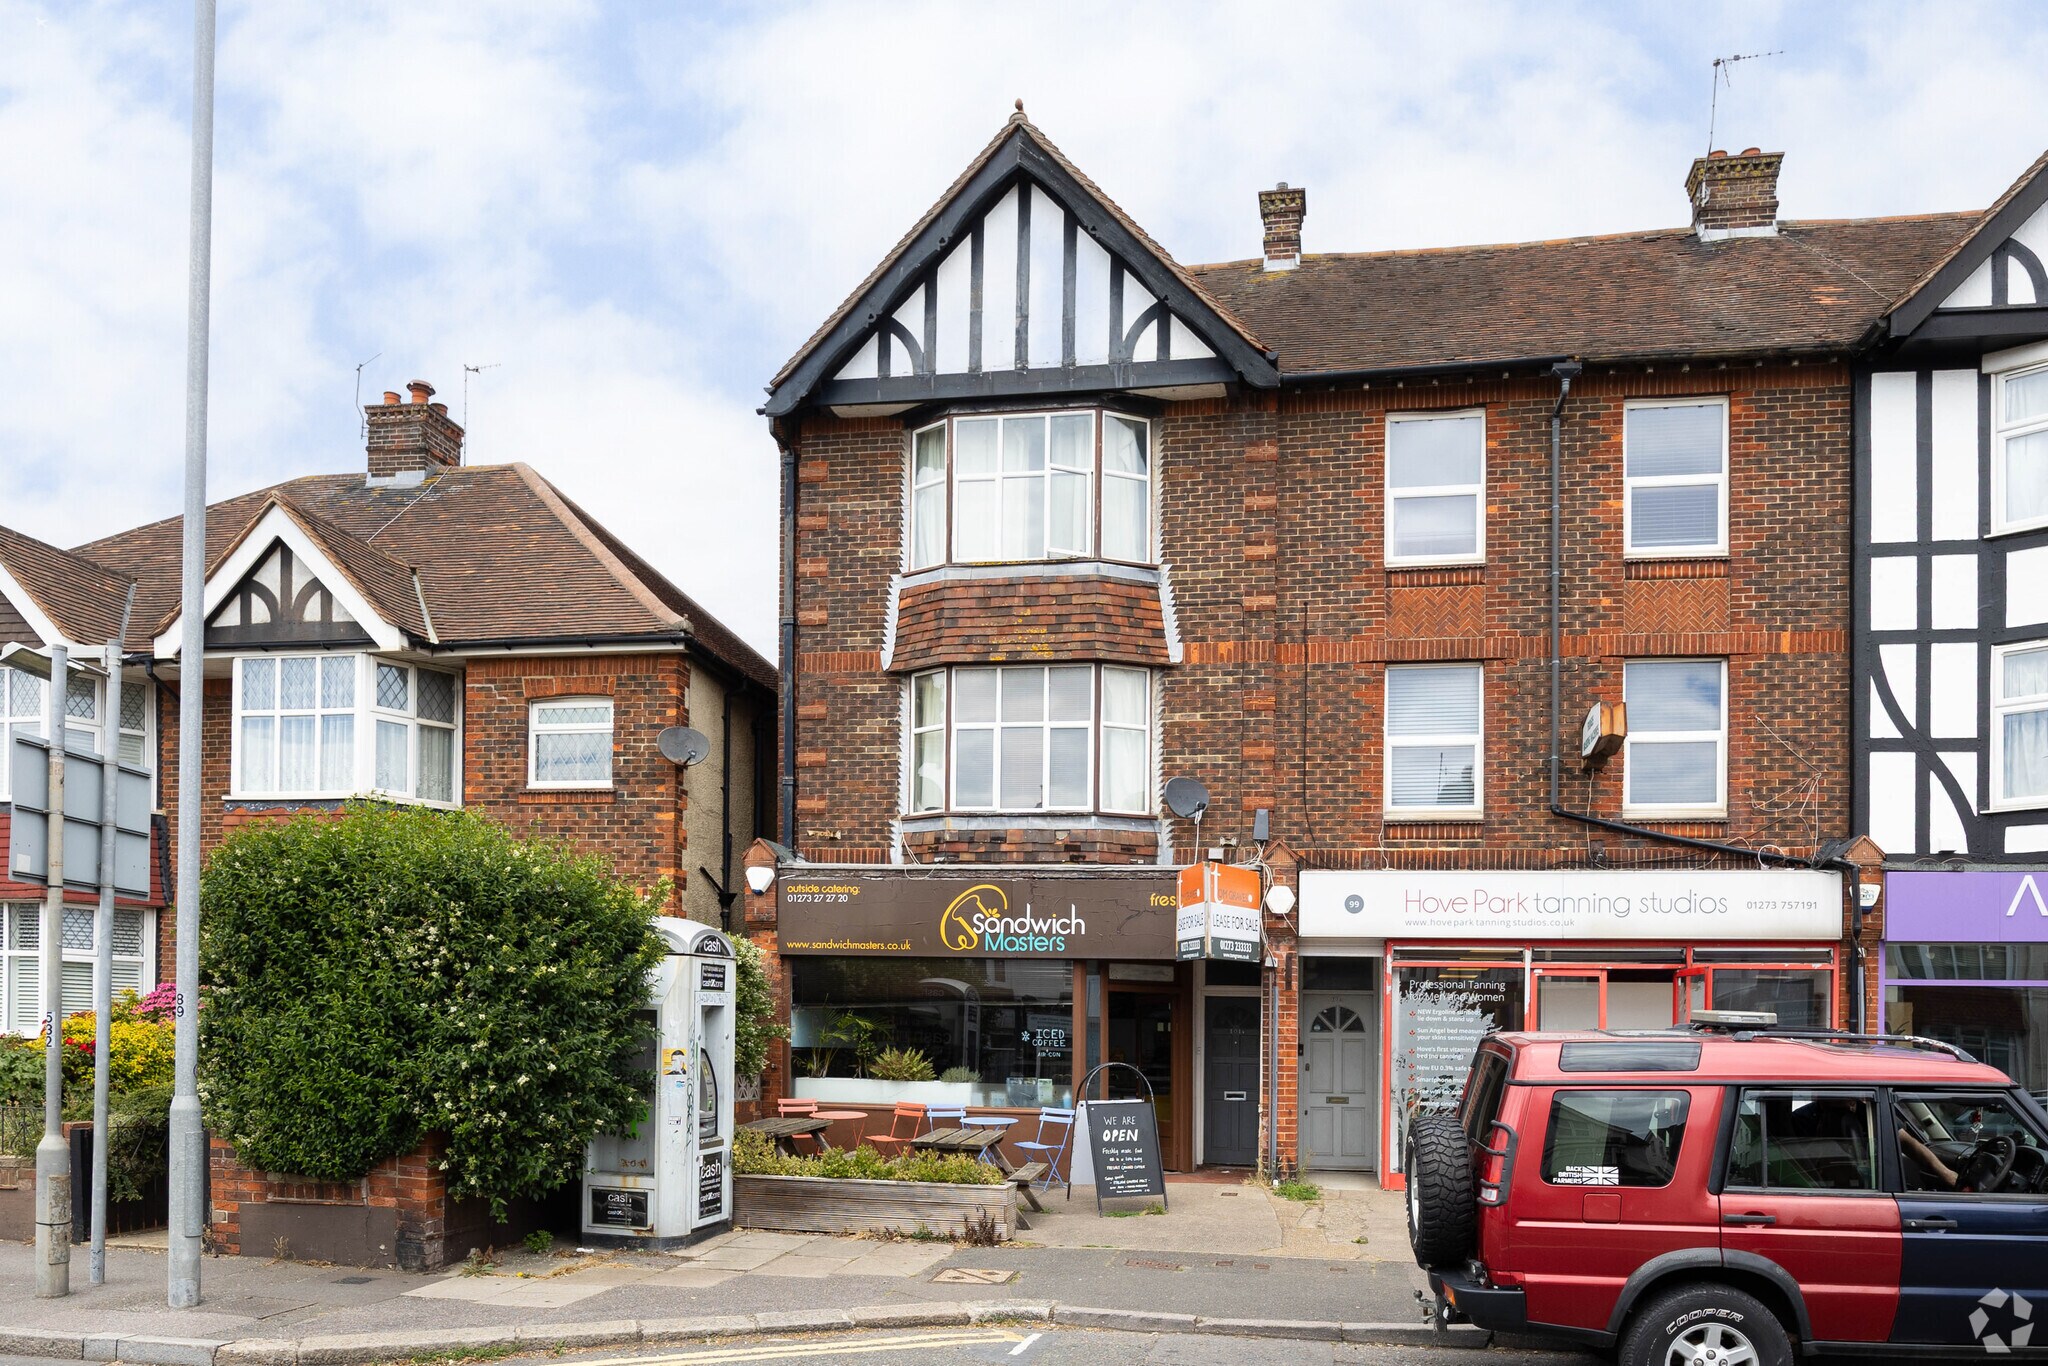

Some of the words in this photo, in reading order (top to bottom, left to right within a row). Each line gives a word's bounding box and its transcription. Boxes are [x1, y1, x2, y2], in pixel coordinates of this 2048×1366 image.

[787, 884, 819, 894] outside
[821, 884, 860, 895] catering:
[787, 894, 812, 903] 01273
[814, 894, 824, 903] 27
[826, 894, 836, 903] 27
[837, 894, 848, 903] 20
[1150, 892, 1176, 907] fres
[1348, 900, 1360, 908] 99
[1405, 889, 1468, 914] Hove
[1474, 889, 1529, 914] Park
[1533, 892, 1631, 918] tanning
[1639, 889, 1728, 914] studios
[1746, 900, 1777, 910] 01273
[1780, 900, 1818, 910] 757191
[972, 903, 1086, 935] Sandwich
[1213, 912, 1230, 929] LEASE
[1231, 915, 1244, 930] FOR
[1245, 917, 1258, 932] SALE
[703, 939, 721, 953] cash
[786, 938, 911, 951] www.sandwichmasters.co.uk
[985, 932, 1066, 952] Masters
[1219, 940, 1234, 951] 01273
[1409, 979, 1466, 989] Professional
[1468, 980, 1506, 992] Tanning
[1423, 992, 1446, 1001] Men
[1469, 992, 1505, 1002] Women
[1433, 1009, 1456, 1017] Ergoline
[1036, 1029, 1055, 1039] ICED
[1032, 1039, 1056, 1047] COFFEE
[1103, 1116, 1117, 1126] WE
[1122, 1116, 1136, 1125] ARE
[1102, 1128, 1139, 1142] OPEN
[701, 1159, 721, 1179] cash
[1665, 1308, 1744, 1335] COOPER
